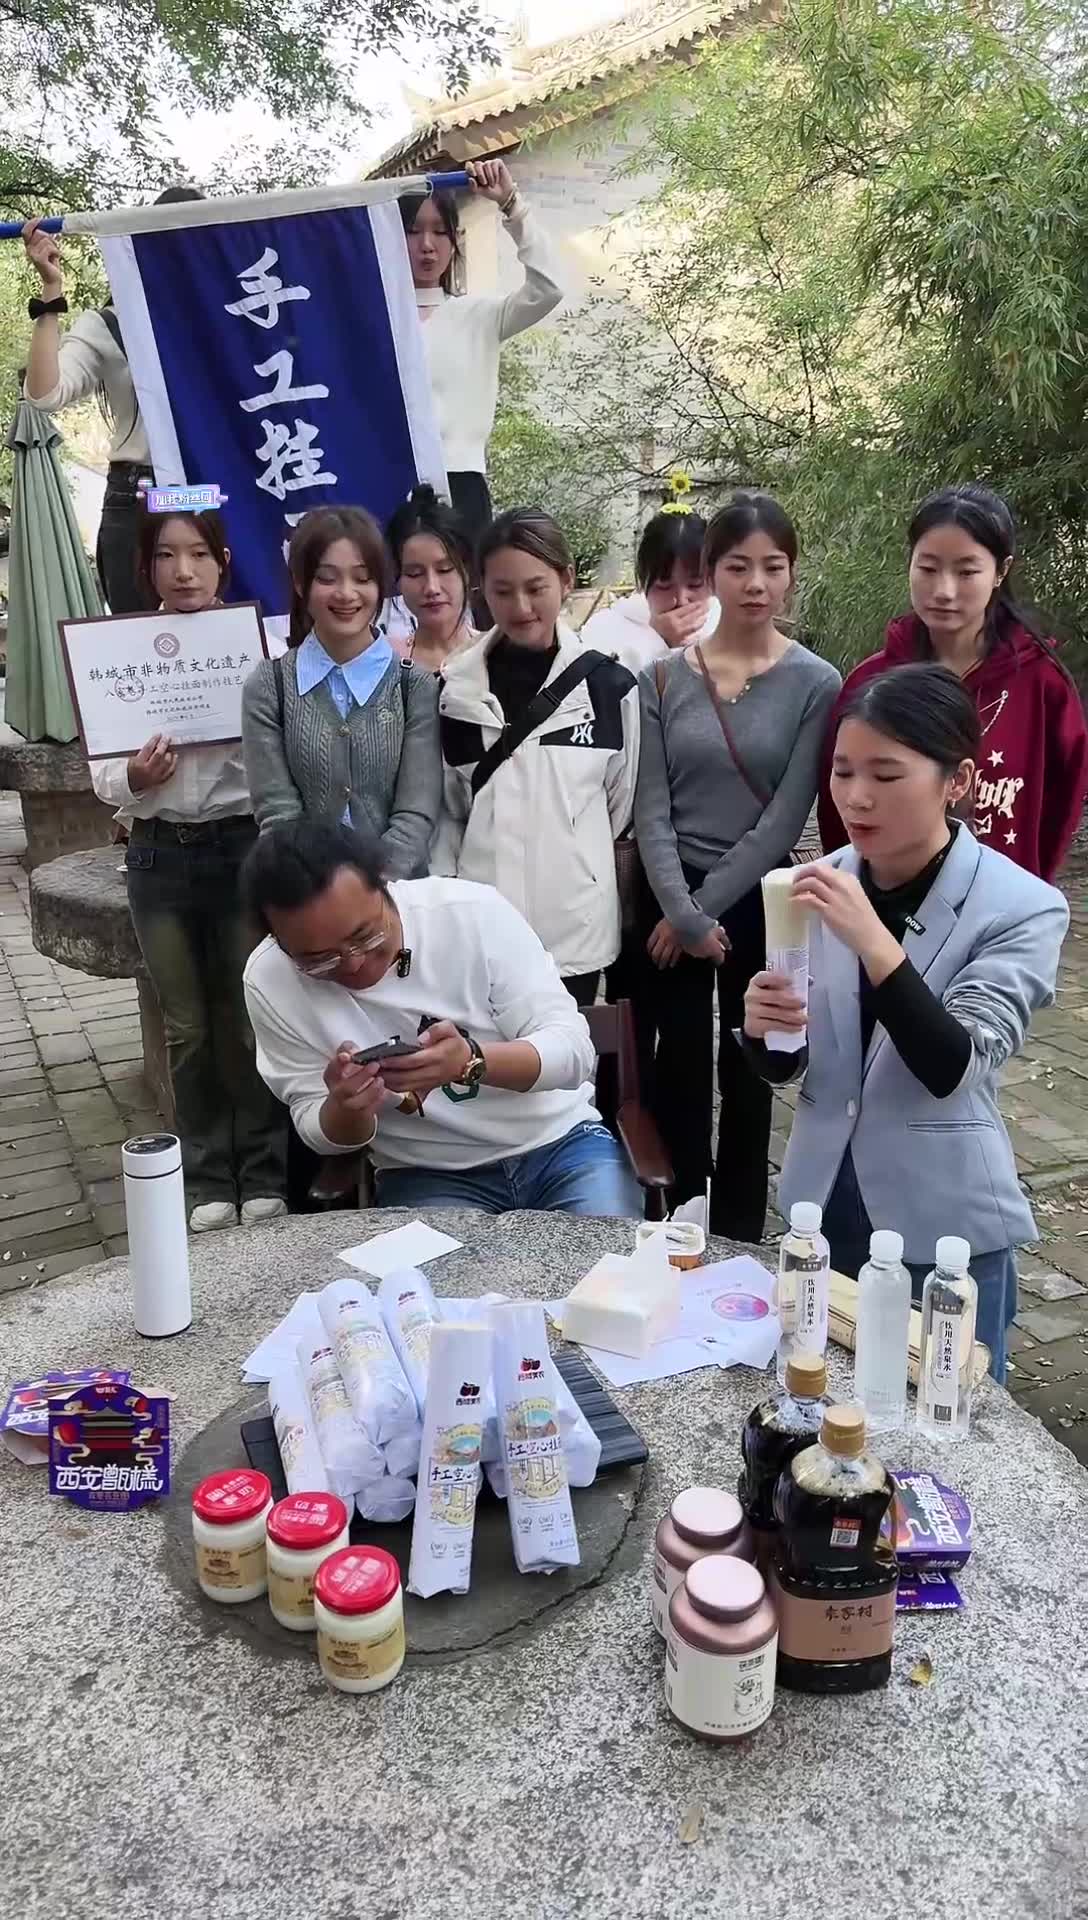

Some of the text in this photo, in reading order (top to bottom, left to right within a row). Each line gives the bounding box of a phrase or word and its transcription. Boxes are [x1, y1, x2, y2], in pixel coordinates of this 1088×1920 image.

[224, 247, 338, 564] 手工挂
[88, 652, 251, 682] 韩城市非物质文化遗产
[570, 722, 594, 745] NY
[943, 1320, 953, 1372] 饮用天然泉水
[508, 1437, 562, 1457] 手工空心挂
[56, 1464, 163, 1491] 西安甑糕
